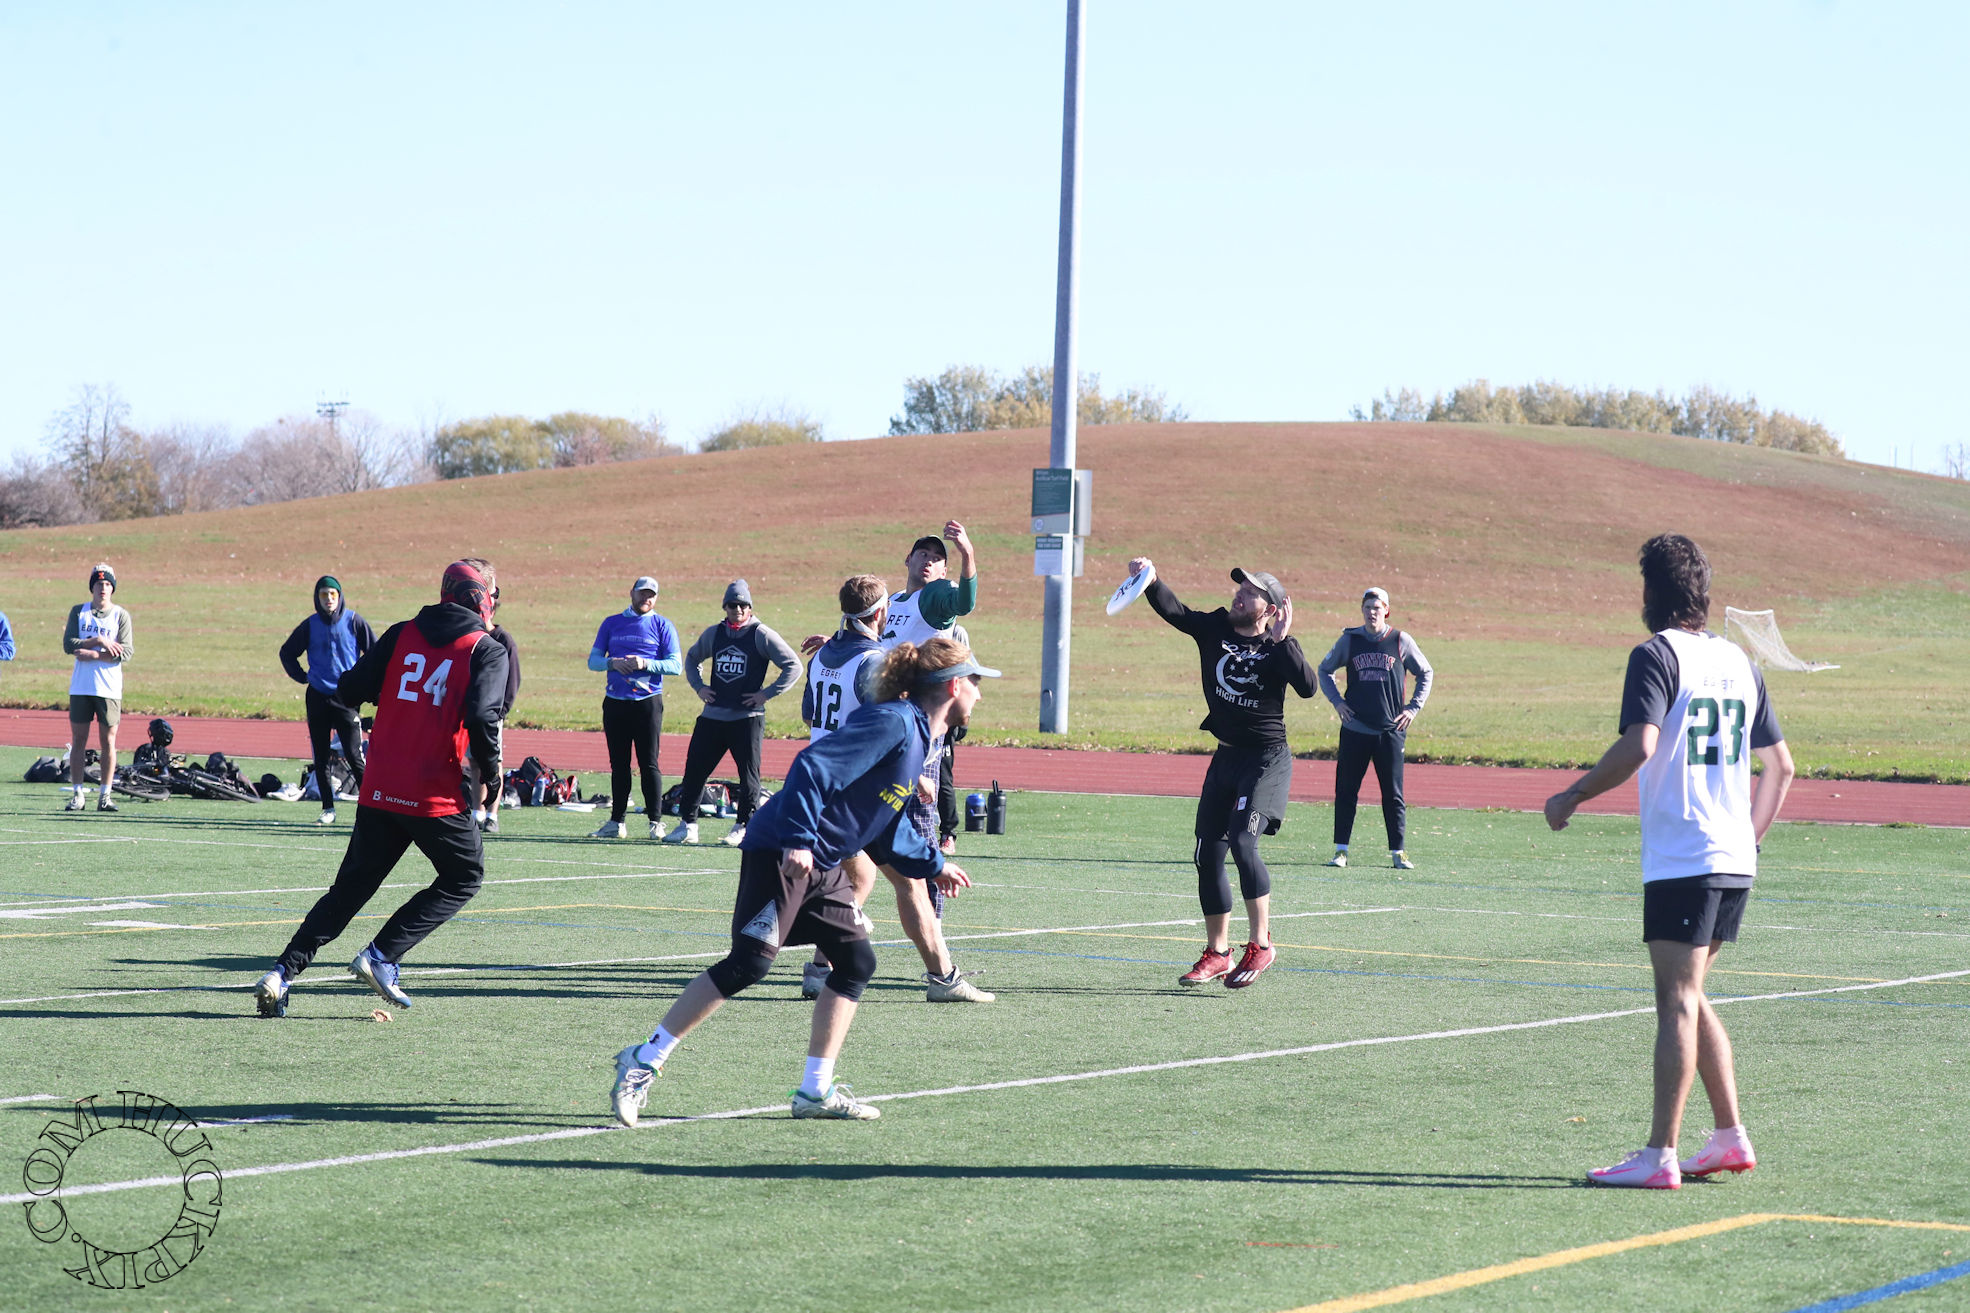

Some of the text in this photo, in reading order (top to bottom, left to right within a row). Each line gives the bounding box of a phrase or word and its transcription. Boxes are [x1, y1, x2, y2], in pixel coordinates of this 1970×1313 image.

[886, 614, 910, 626] RET
[81, 624, 111, 636] EGRET
[716, 662, 743, 674] TCUL
[1352, 652, 1397, 672] KANSAS
[397, 652, 453, 706] 24
[820, 668, 842, 680] EGRET
[812, 680, 842, 731] 12
[1215, 686, 1260, 708] HIGH LIFE
[1687, 697, 1746, 766] 23
[372, 790, 420, 808] B ULTIMATE
